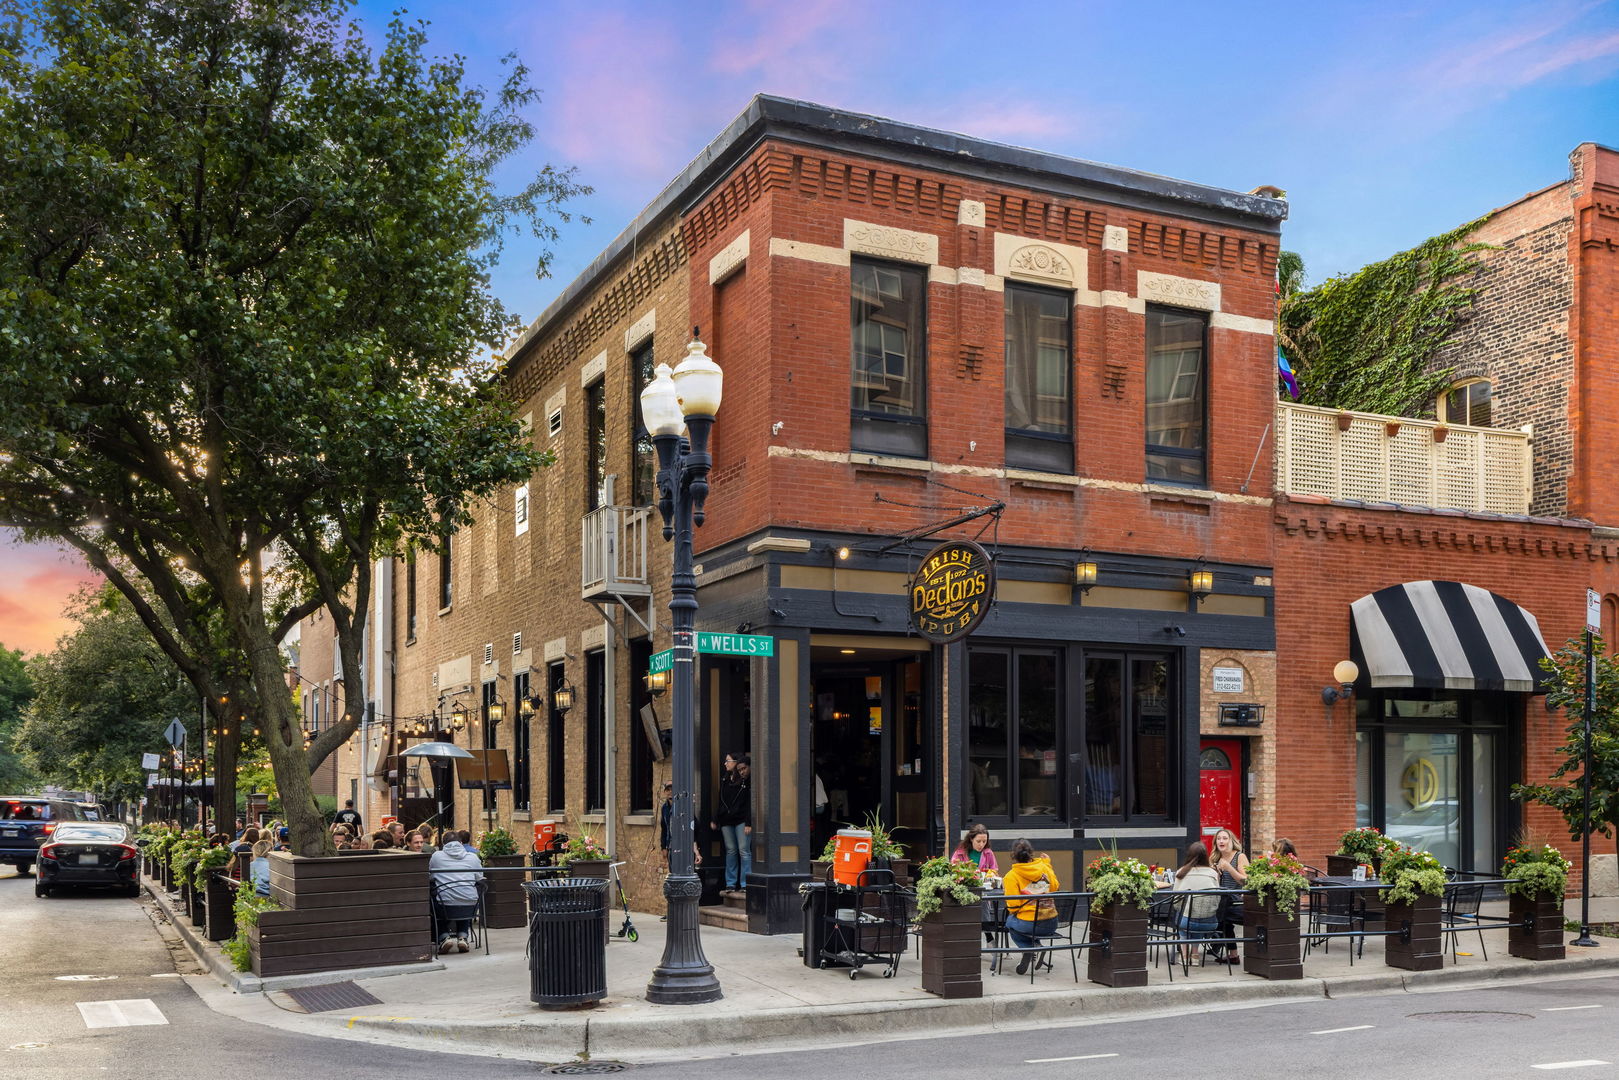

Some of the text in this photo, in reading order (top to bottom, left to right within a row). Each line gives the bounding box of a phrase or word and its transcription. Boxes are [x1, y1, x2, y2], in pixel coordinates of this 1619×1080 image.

[923, 549, 973, 578] IRISH
[913, 570, 985, 613] Declan's
[930, 576, 944, 586] EST
[928, 612, 971, 635] PUB
[701, 635, 769, 653] N WELLS ST
[655, 652, 670, 671] SCOTT
